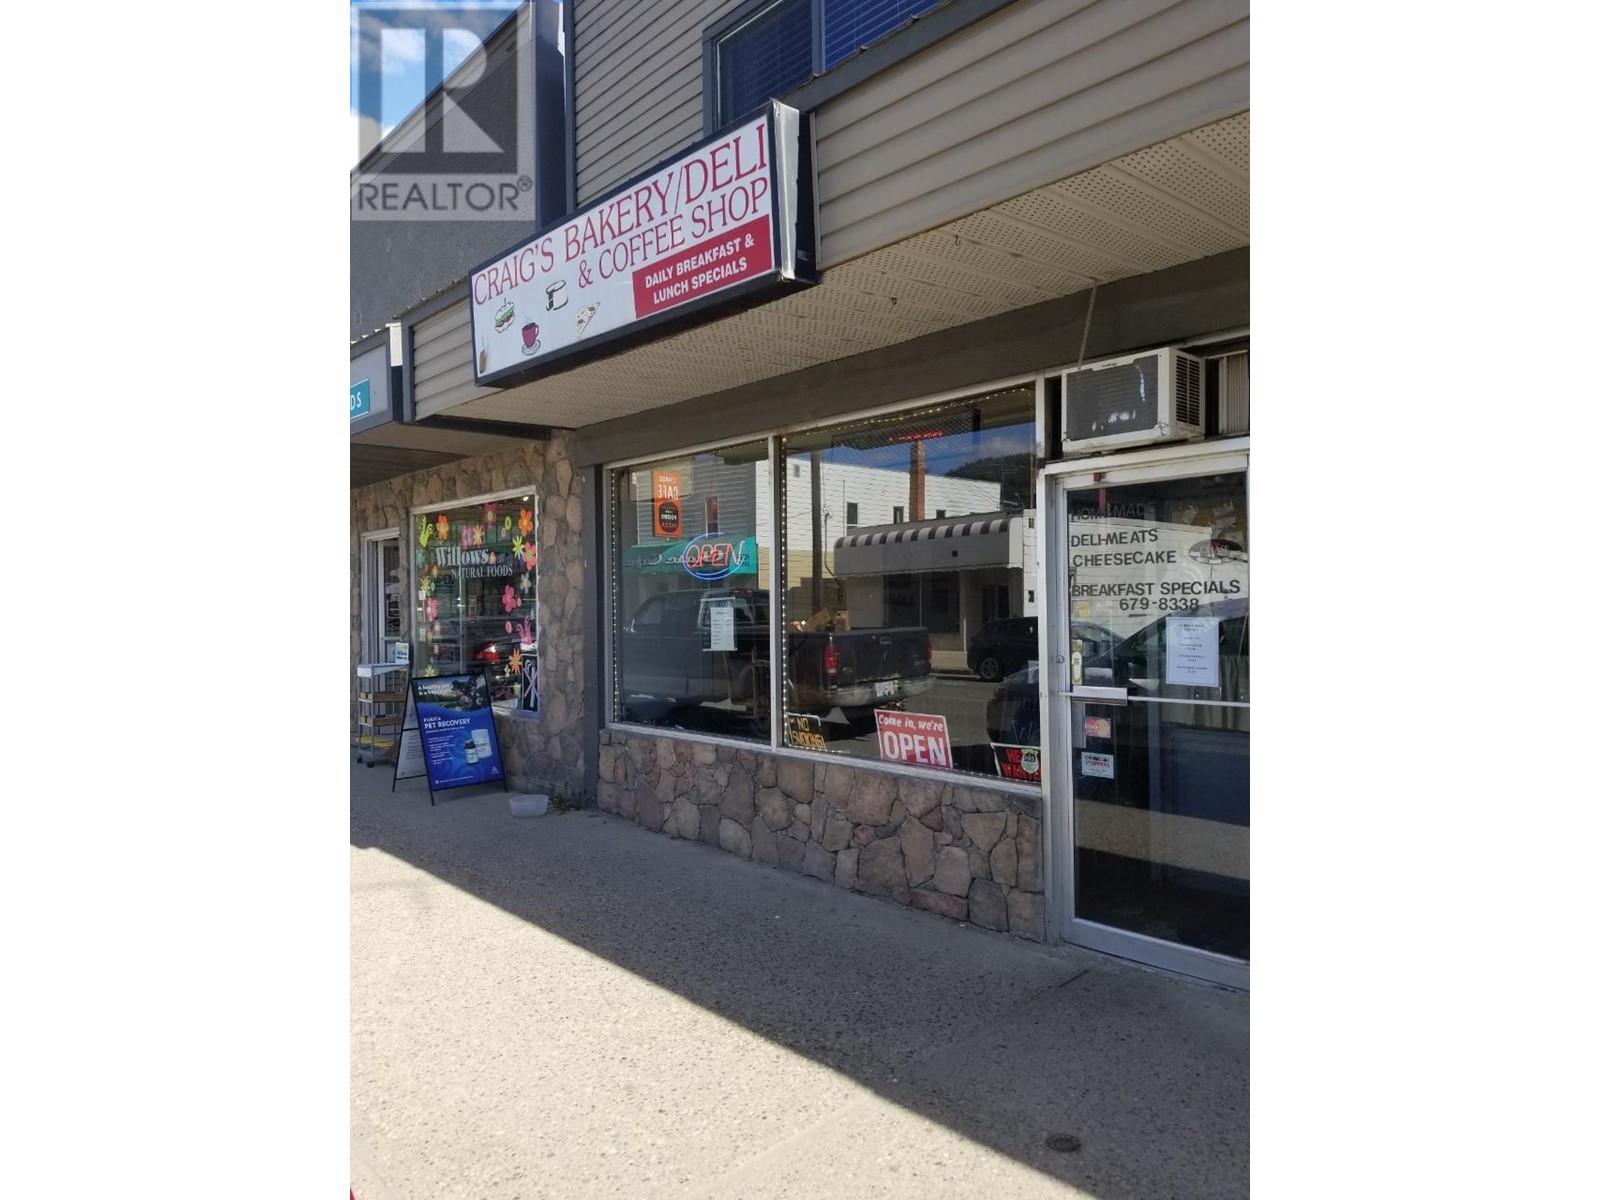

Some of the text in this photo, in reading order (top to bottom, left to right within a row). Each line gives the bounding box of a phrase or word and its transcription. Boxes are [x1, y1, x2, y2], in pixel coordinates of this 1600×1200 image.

[474, 124, 767, 305] CRAIG'S BAKERY/DELI
[578, 177, 768, 288] & COFFEE SHOP
[645, 233, 754, 288] DAILY BREAKFAST &
[653, 257, 747, 304] LUNCH SPECIALS
[1071, 529, 1159, 547] DELI-MEATS
[435, 545, 489, 567] Willows
[685, 540, 745, 568] OPEN
[1073, 550, 1177, 567] CHEESECAKE
[451, 564, 513, 579] NATURAL FOODS
[1071, 579, 1241, 597] BREAKFAST SPECIALS
[1119, 598, 1200, 611] 679-8338
[424, 717, 471, 729] PET RECOVERY
[797, 717, 809, 731] NO
[878, 714, 901, 727] Come
[918, 720, 944, 732] we're
[883, 731, 945, 765] OPEN
